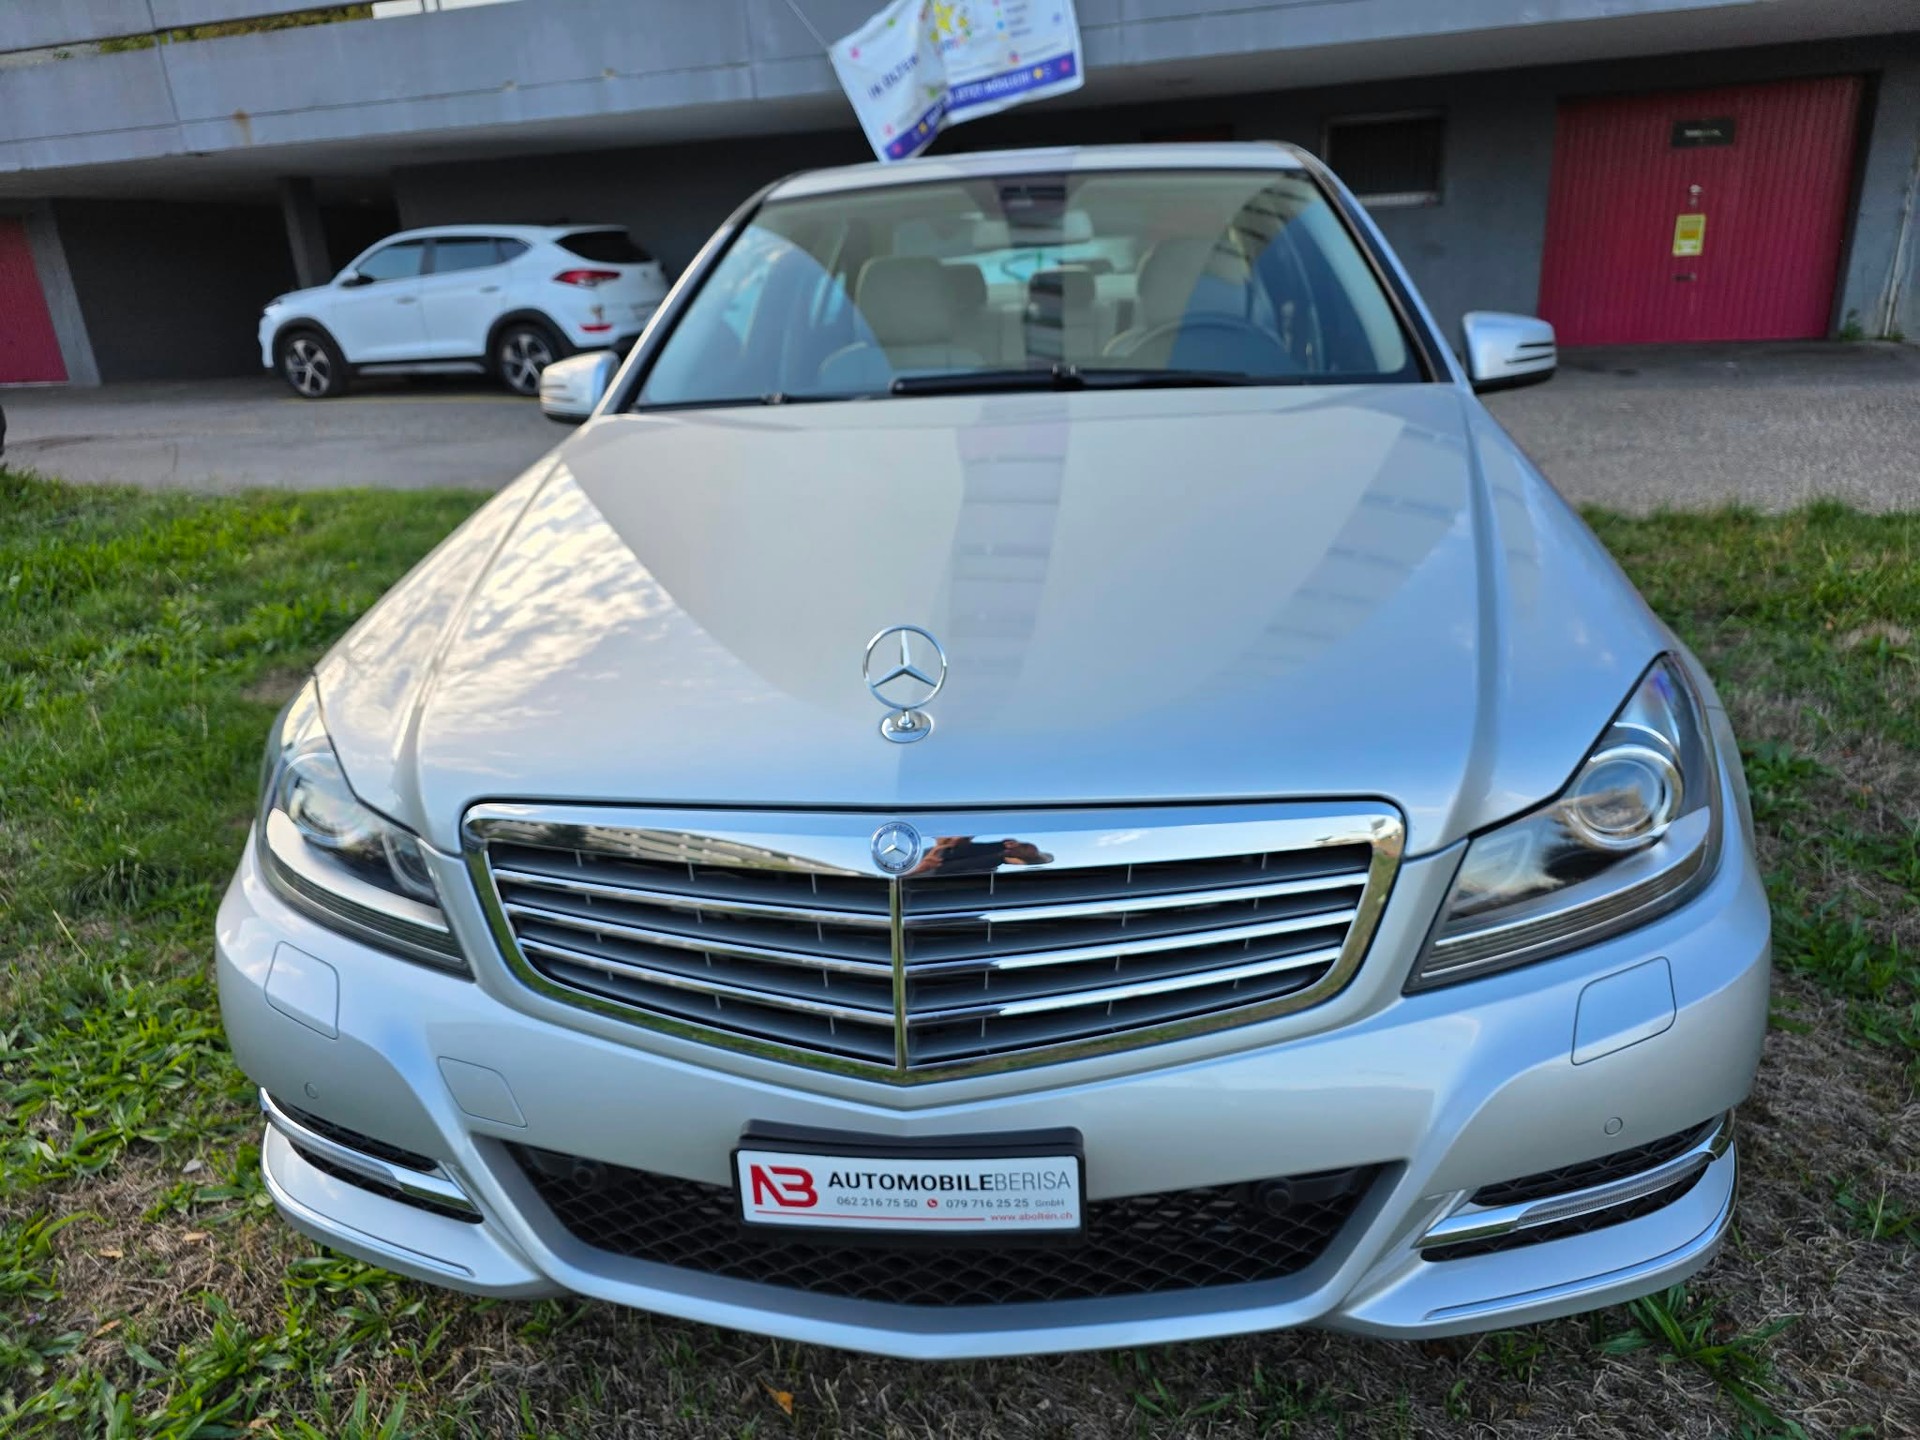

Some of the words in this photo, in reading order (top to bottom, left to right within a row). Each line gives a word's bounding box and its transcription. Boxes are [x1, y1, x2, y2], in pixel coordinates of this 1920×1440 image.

[836, 1196, 858, 1206] 062
[862, 1197, 883, 1207] 216
[887, 1199, 900, 1208] 75
[903, 1199, 918, 1208] 50
[946, 1199, 968, 1208] 079
[972, 1199, 993, 1208] 716
[997, 1199, 1011, 1208] 25
[1014, 1199, 1029, 1208] 25
[991, 1211, 1073, 1221] www.abolten.ch
